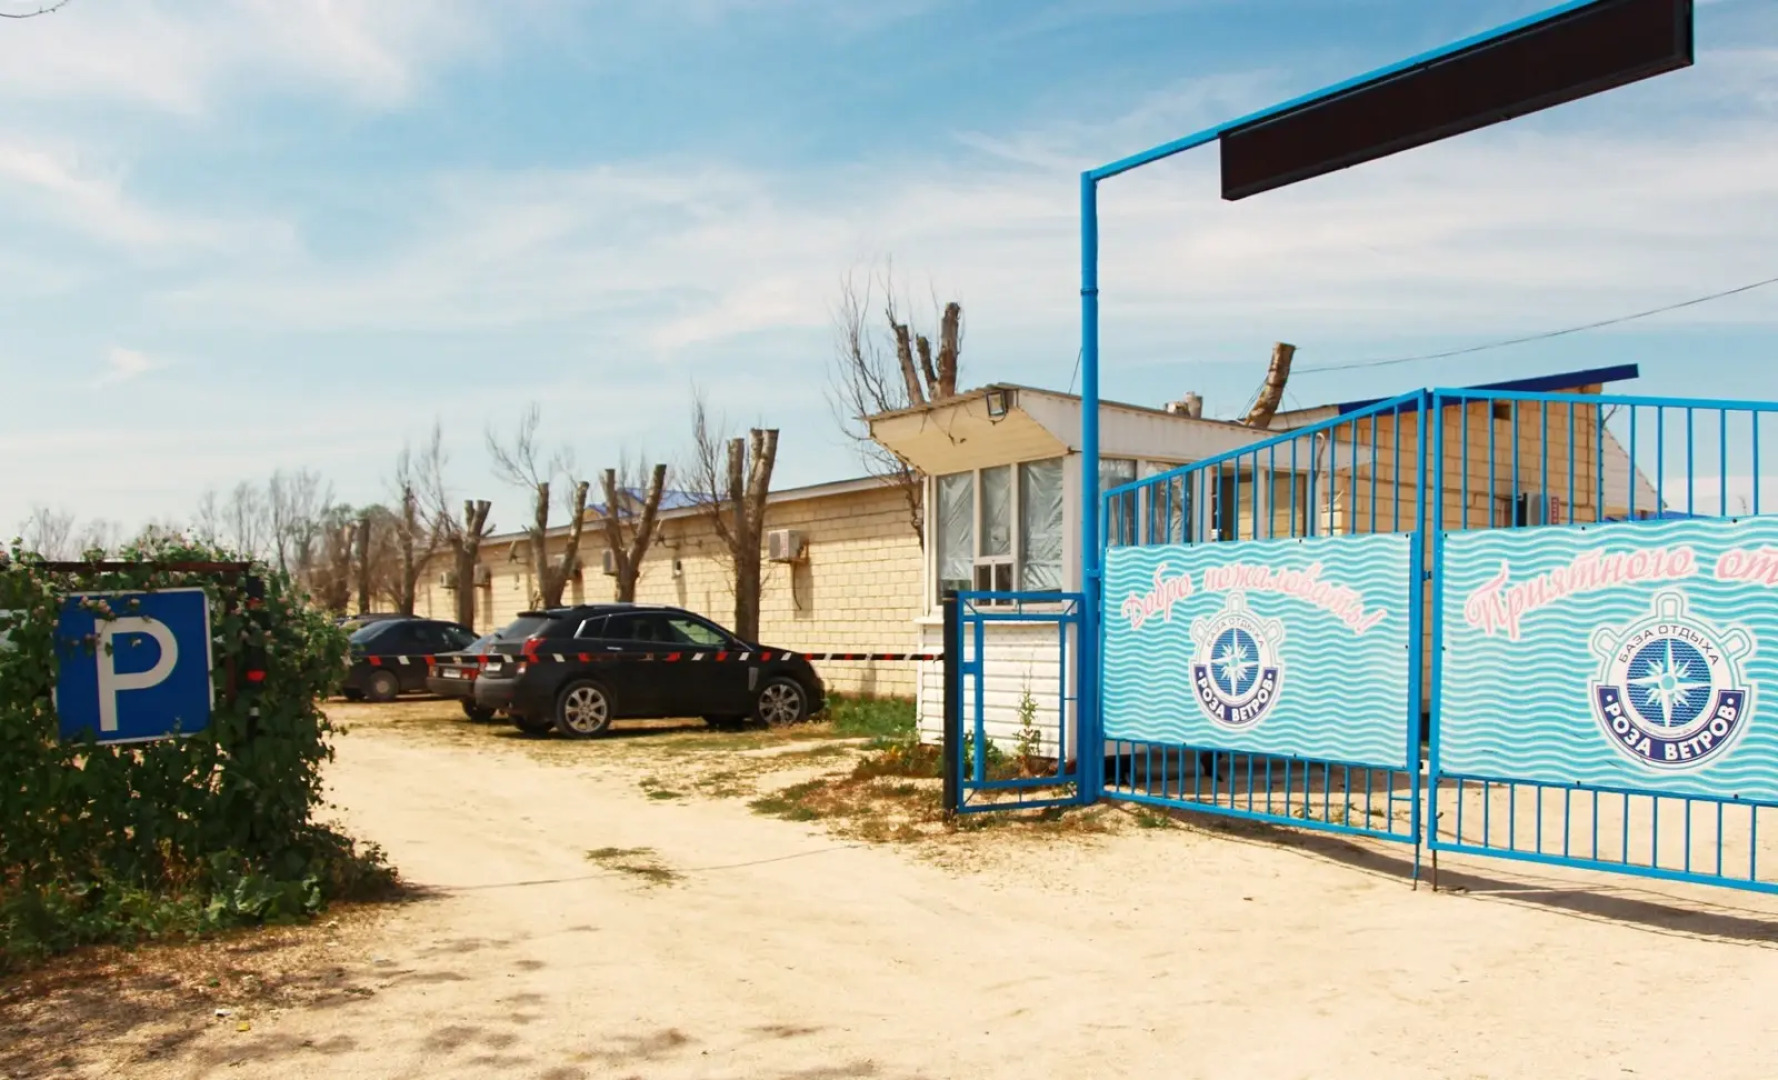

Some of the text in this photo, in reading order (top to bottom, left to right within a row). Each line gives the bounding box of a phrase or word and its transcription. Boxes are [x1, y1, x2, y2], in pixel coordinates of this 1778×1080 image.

[1121, 561, 1387, 635] Добро пожаловать!
[1465, 548, 1694, 639] Приятного
[94, 616, 178, 732] P
[1619, 625, 1719, 665] БАЗА ОТДЫХА
[1198, 677, 1274, 722] РОЗА ВЕТРОВ
[1604, 702, 1737, 760] РОЗА ВЕТРОВ
